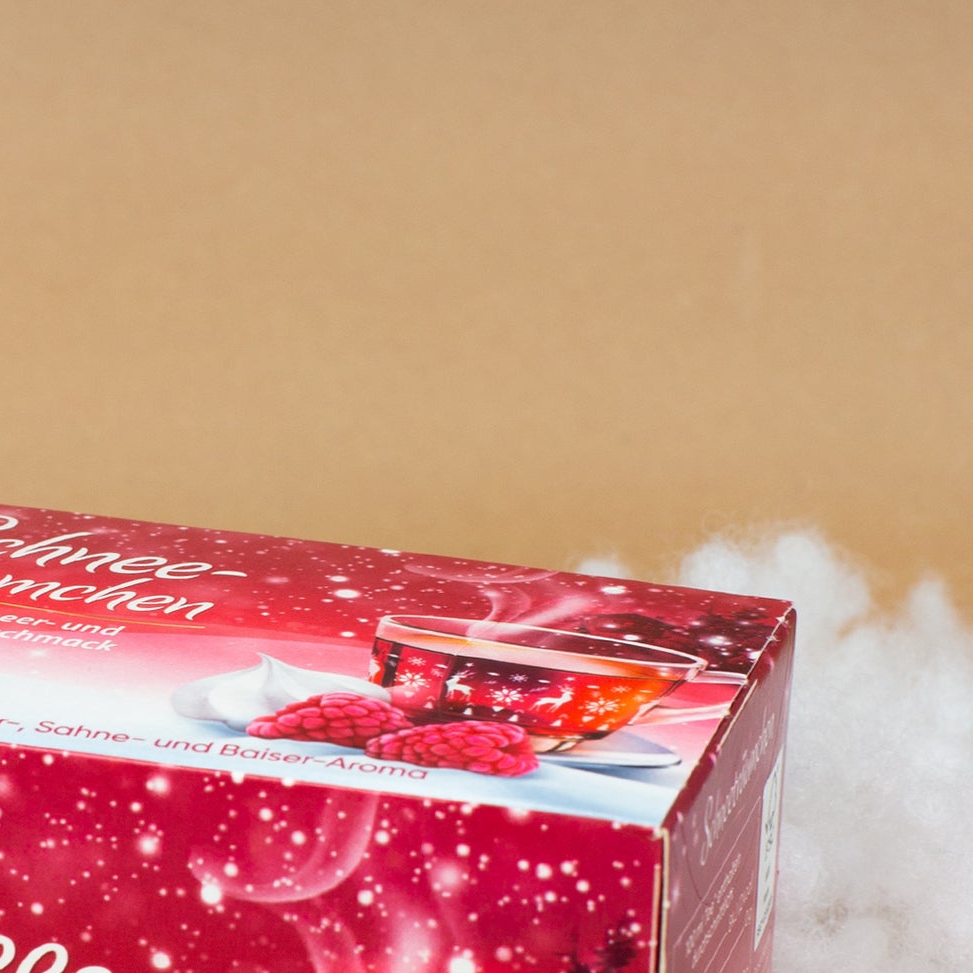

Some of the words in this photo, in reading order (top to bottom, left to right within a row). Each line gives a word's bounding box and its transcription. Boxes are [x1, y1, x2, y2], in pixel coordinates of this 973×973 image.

[61, 620, 125, 637] und
[34, 720, 146, 743] Sahne-
[154, 736, 213, 754] und
[219, 742, 428, 780] Baiser-Aroma
